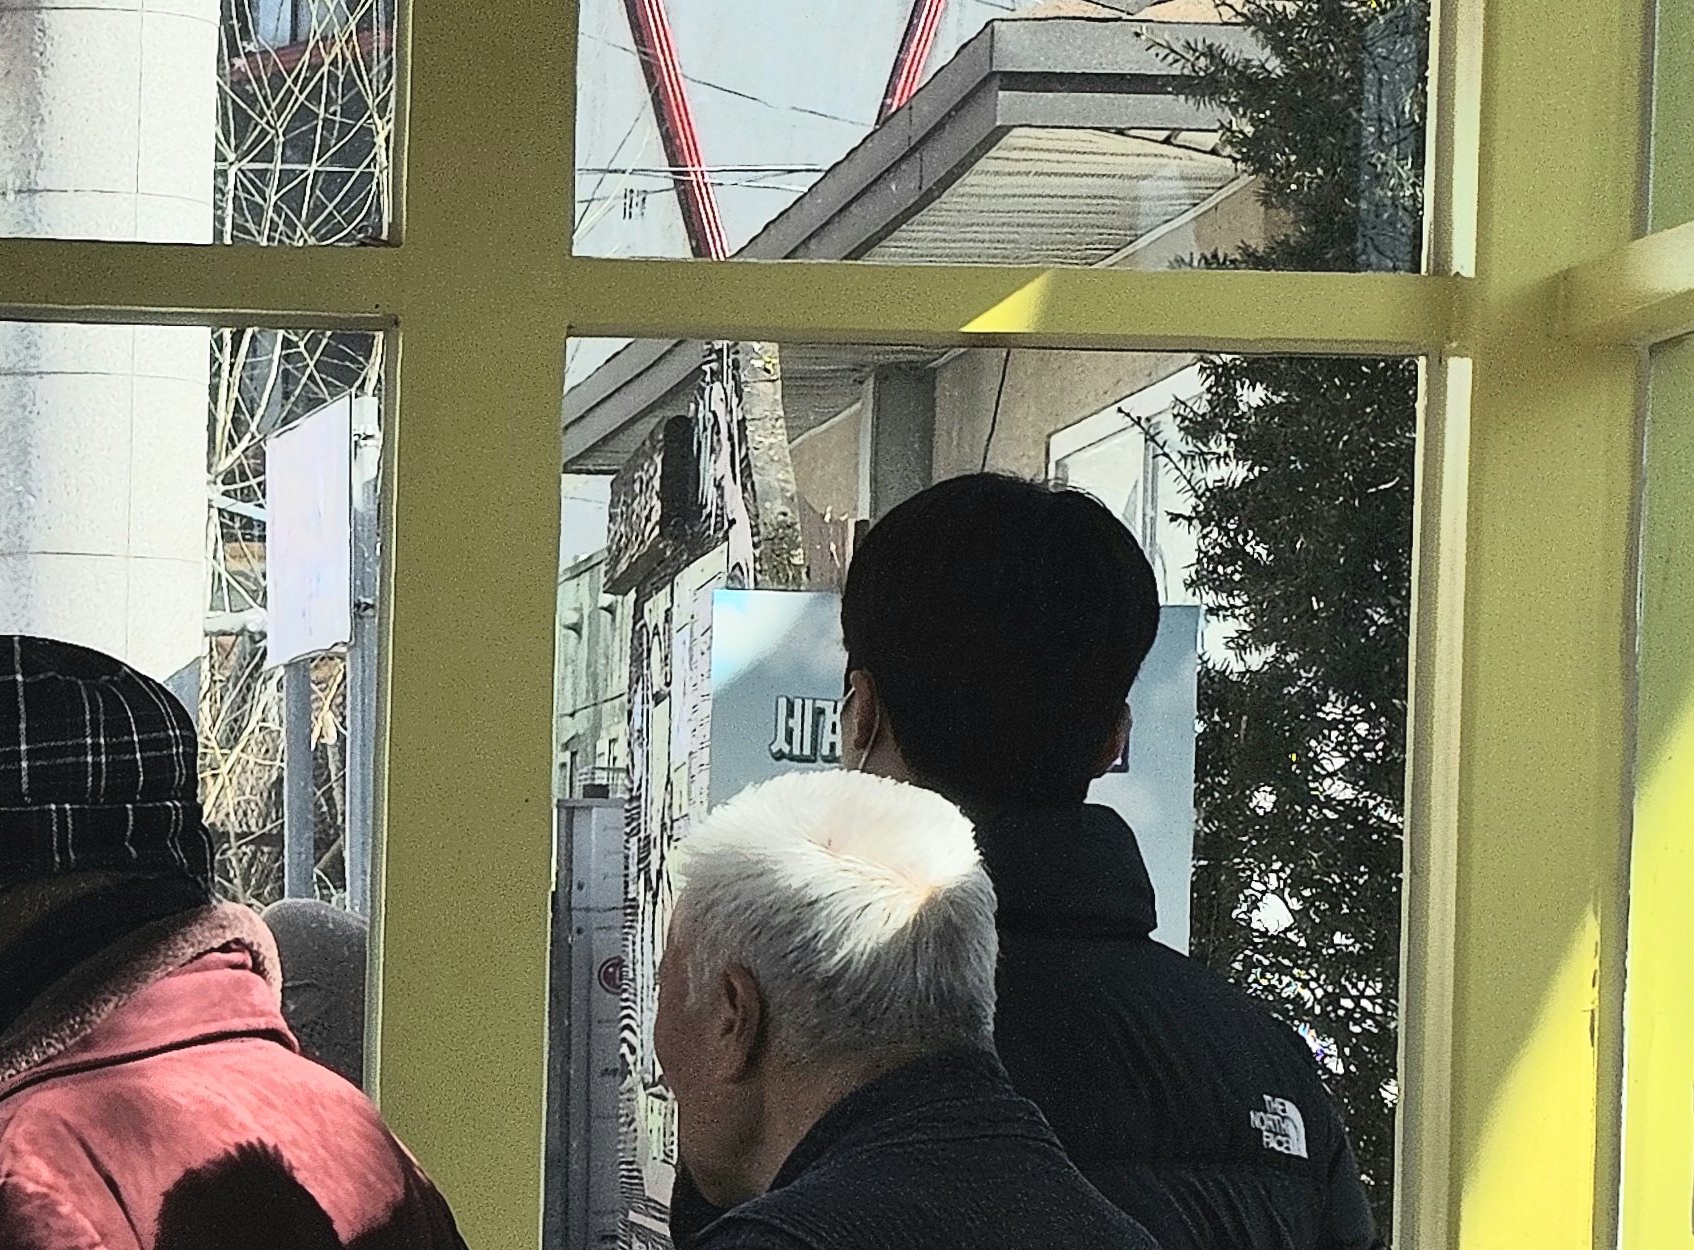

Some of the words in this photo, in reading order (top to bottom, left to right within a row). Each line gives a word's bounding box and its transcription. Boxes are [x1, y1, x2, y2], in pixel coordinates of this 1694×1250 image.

[1263, 1094, 1287, 1116] THE
[1249, 1110, 1288, 1135] NORTH
[1262, 1131, 1291, 1154] FACE
